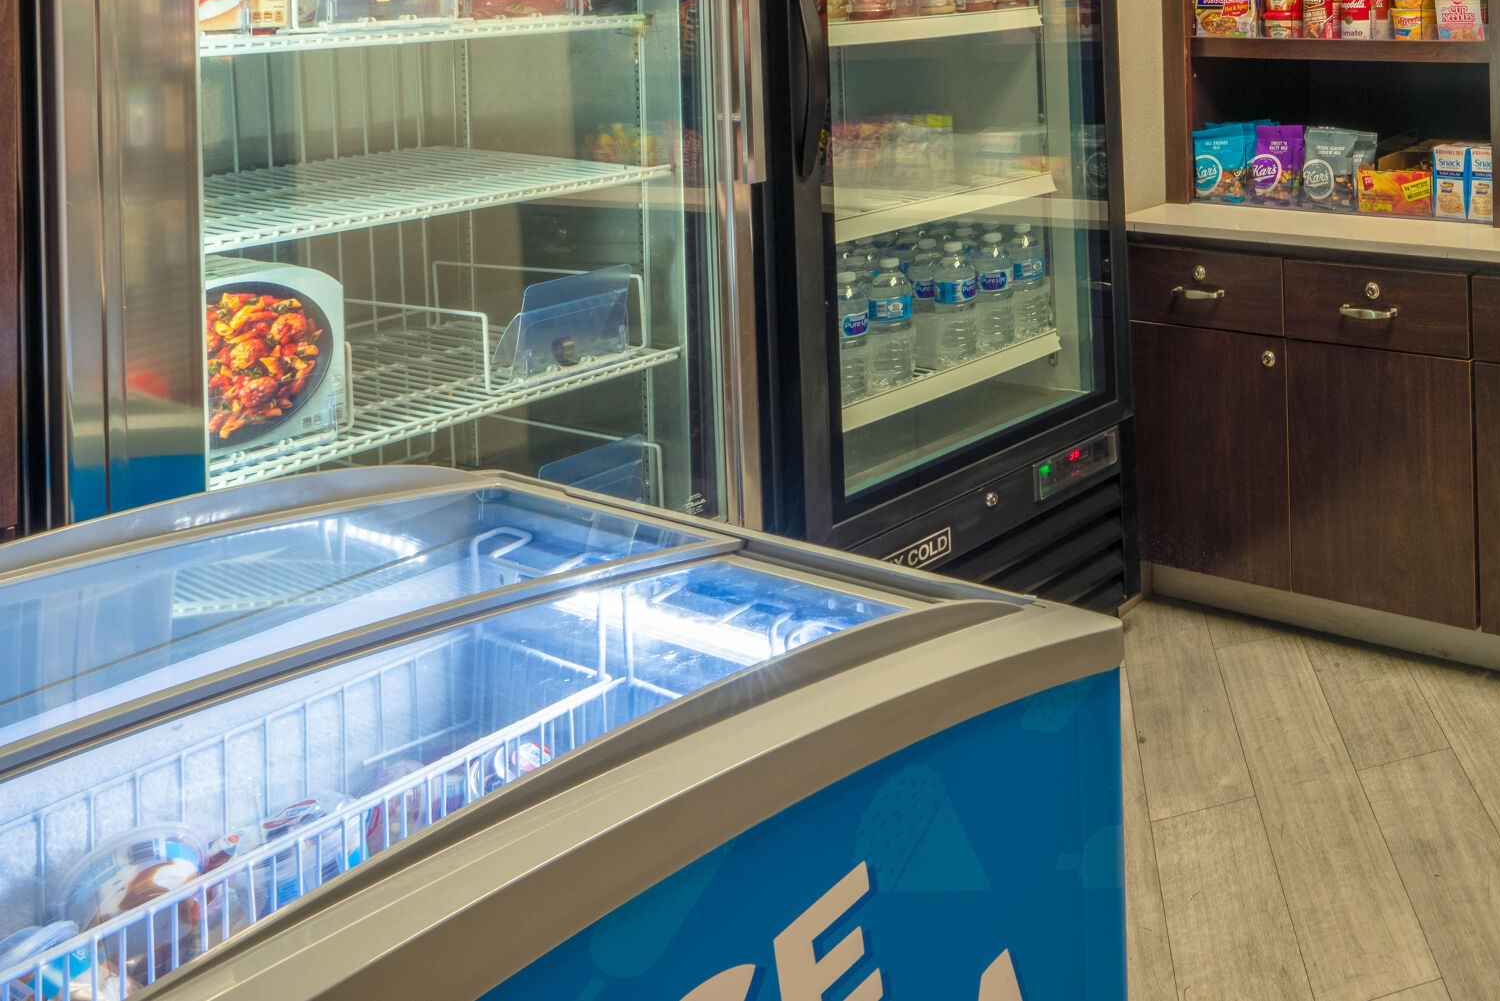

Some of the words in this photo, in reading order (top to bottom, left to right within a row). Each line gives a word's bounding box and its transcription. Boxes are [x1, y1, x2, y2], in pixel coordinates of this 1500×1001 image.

[1449, 5, 1468, 13] CUP
[1442, 12, 1475, 22] NOODLES
[1438, 158, 1461, 167] Snack
[1196, 164, 1218, 177] Kar's
[1253, 164, 1277, 177] Kar's
[1304, 170, 1330, 183] Kar's
[908, 535, 948, 566] COLD
